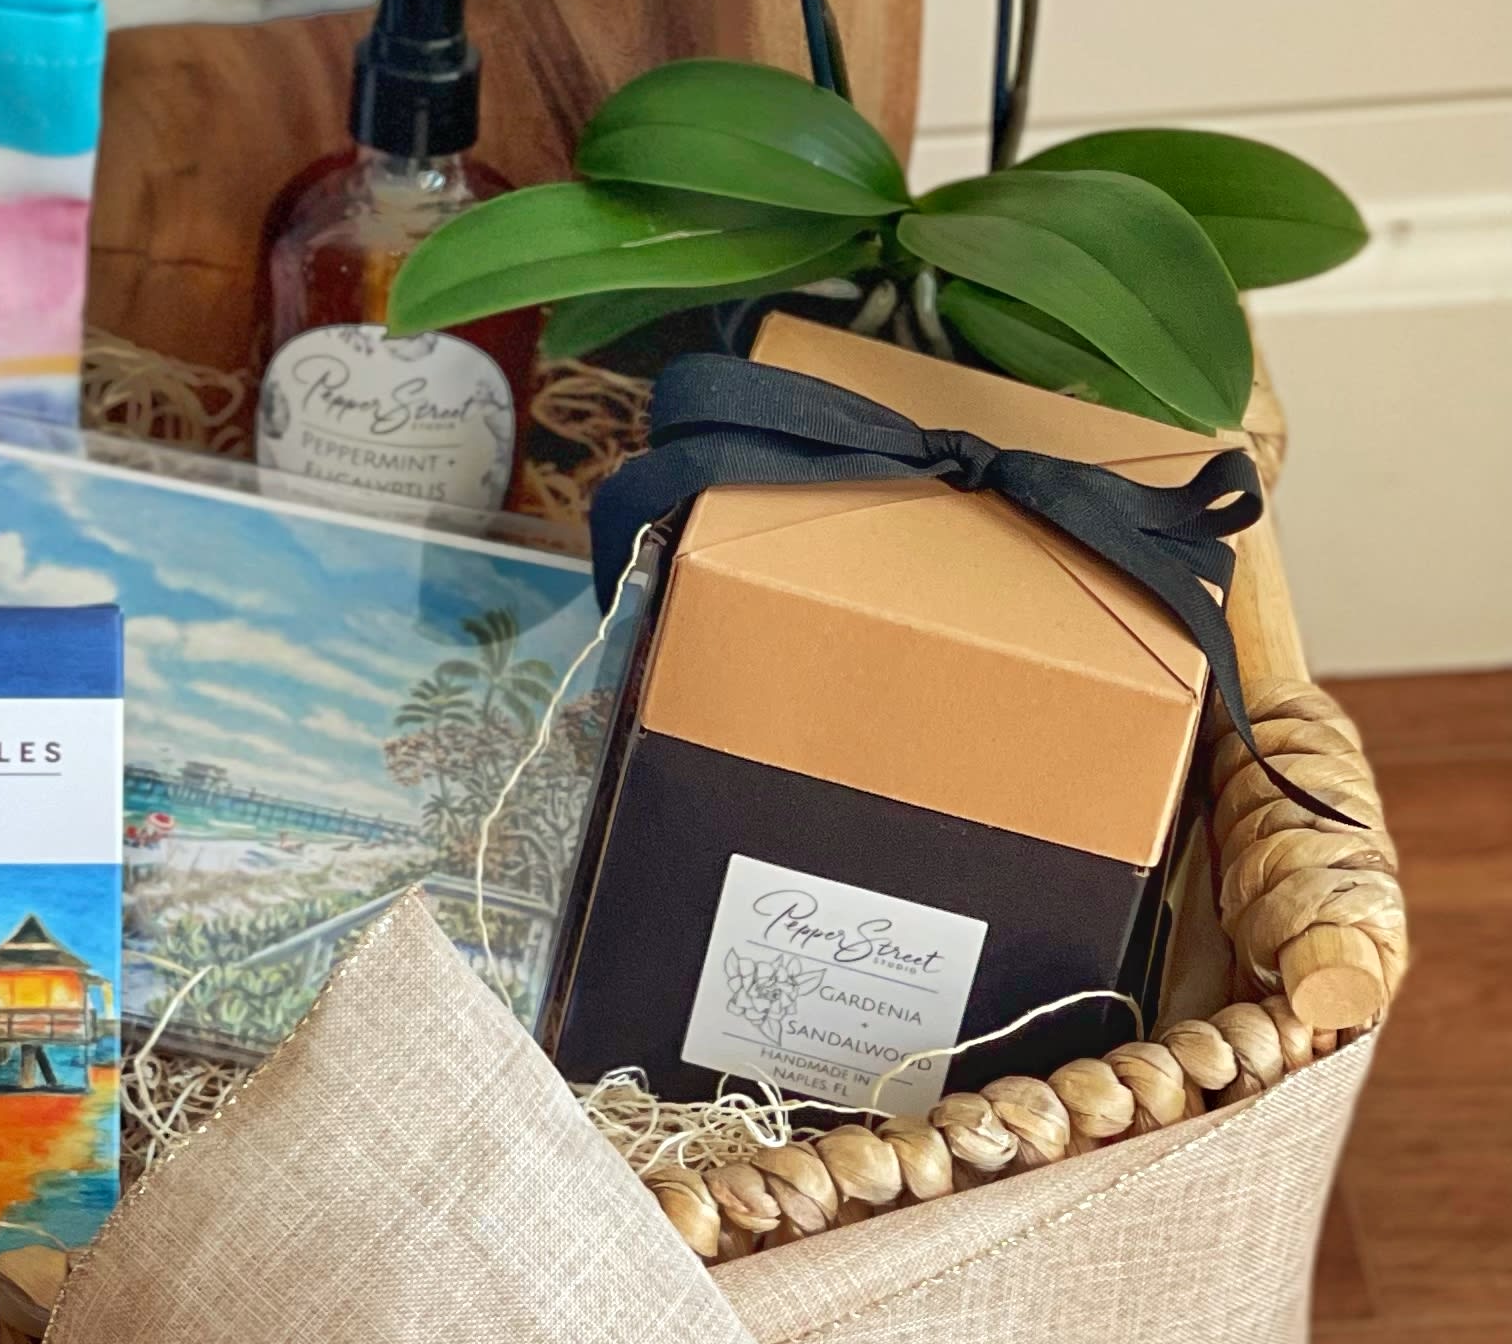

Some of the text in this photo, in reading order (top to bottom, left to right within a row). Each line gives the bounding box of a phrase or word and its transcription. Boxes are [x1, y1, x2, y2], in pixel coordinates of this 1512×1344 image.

[300, 430, 440, 473] PEPPERMINT
[753, 890, 945, 974] Pepper Street
[819, 985, 922, 1026] GARDENIA
[786, 1019, 933, 1072] SANDALWOOD
[759, 1047, 871, 1087] HANDMADE IN
[833, 1083, 849, 1097] FL
